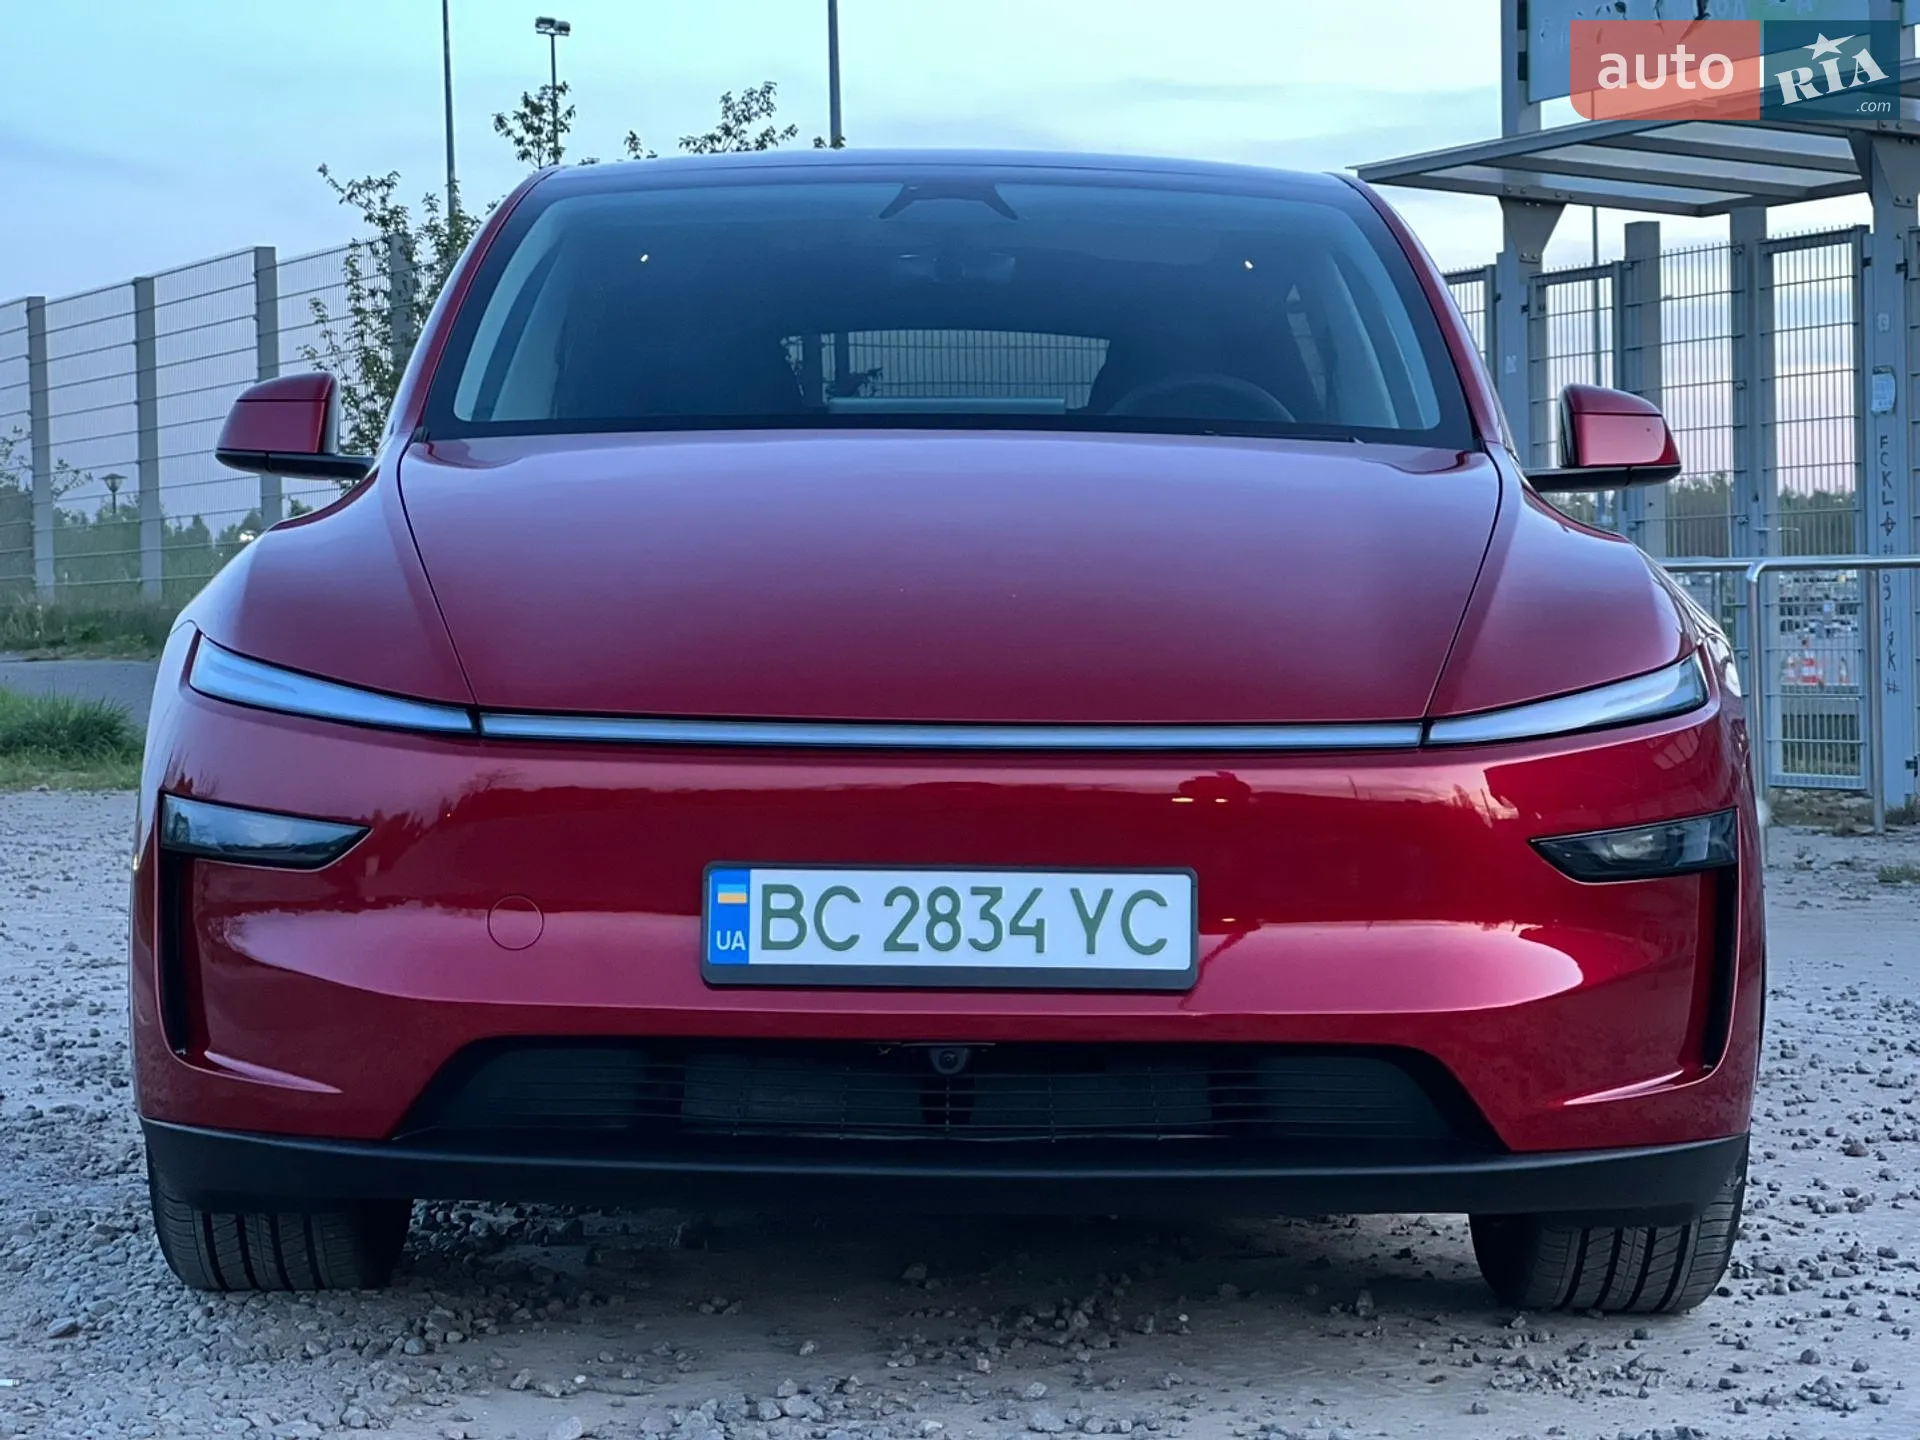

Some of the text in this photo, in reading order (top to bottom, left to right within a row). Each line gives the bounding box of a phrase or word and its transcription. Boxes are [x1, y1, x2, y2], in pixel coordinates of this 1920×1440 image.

[716, 931, 746, 951] UA
[761, 884, 1168, 956] BC 2834 YC
